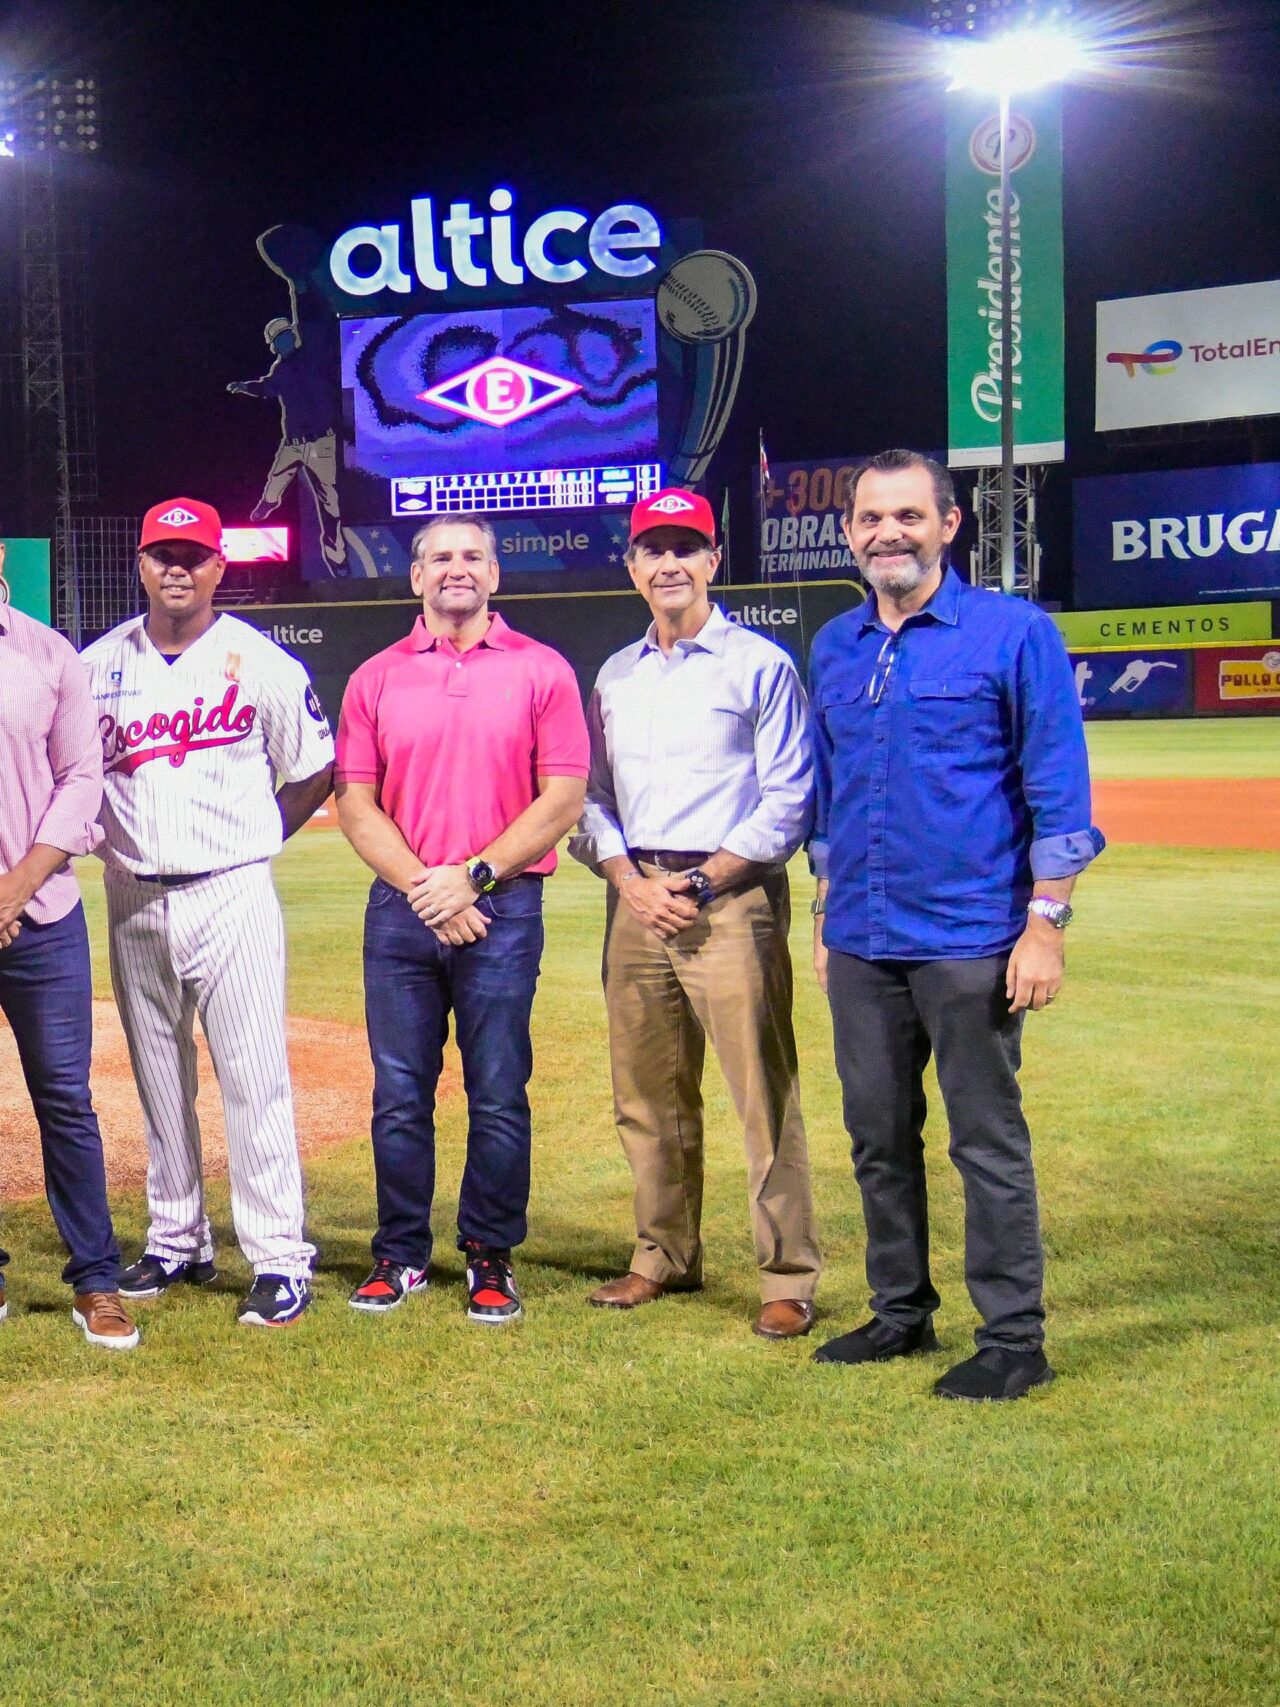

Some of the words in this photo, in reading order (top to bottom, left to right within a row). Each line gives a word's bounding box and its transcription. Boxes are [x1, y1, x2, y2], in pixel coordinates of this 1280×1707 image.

[329, 188, 661, 296] altice
[971, 186, 1022, 423] Presidente
[1188, 337, 1280, 363] TotalEn
[485, 371, 515, 411] E
[502, 529, 589, 556] simple
[725, 604, 798, 626] altice
[1100, 617, 1230, 637] CEMENTOS
[1221, 673, 1271, 687] POLLO
